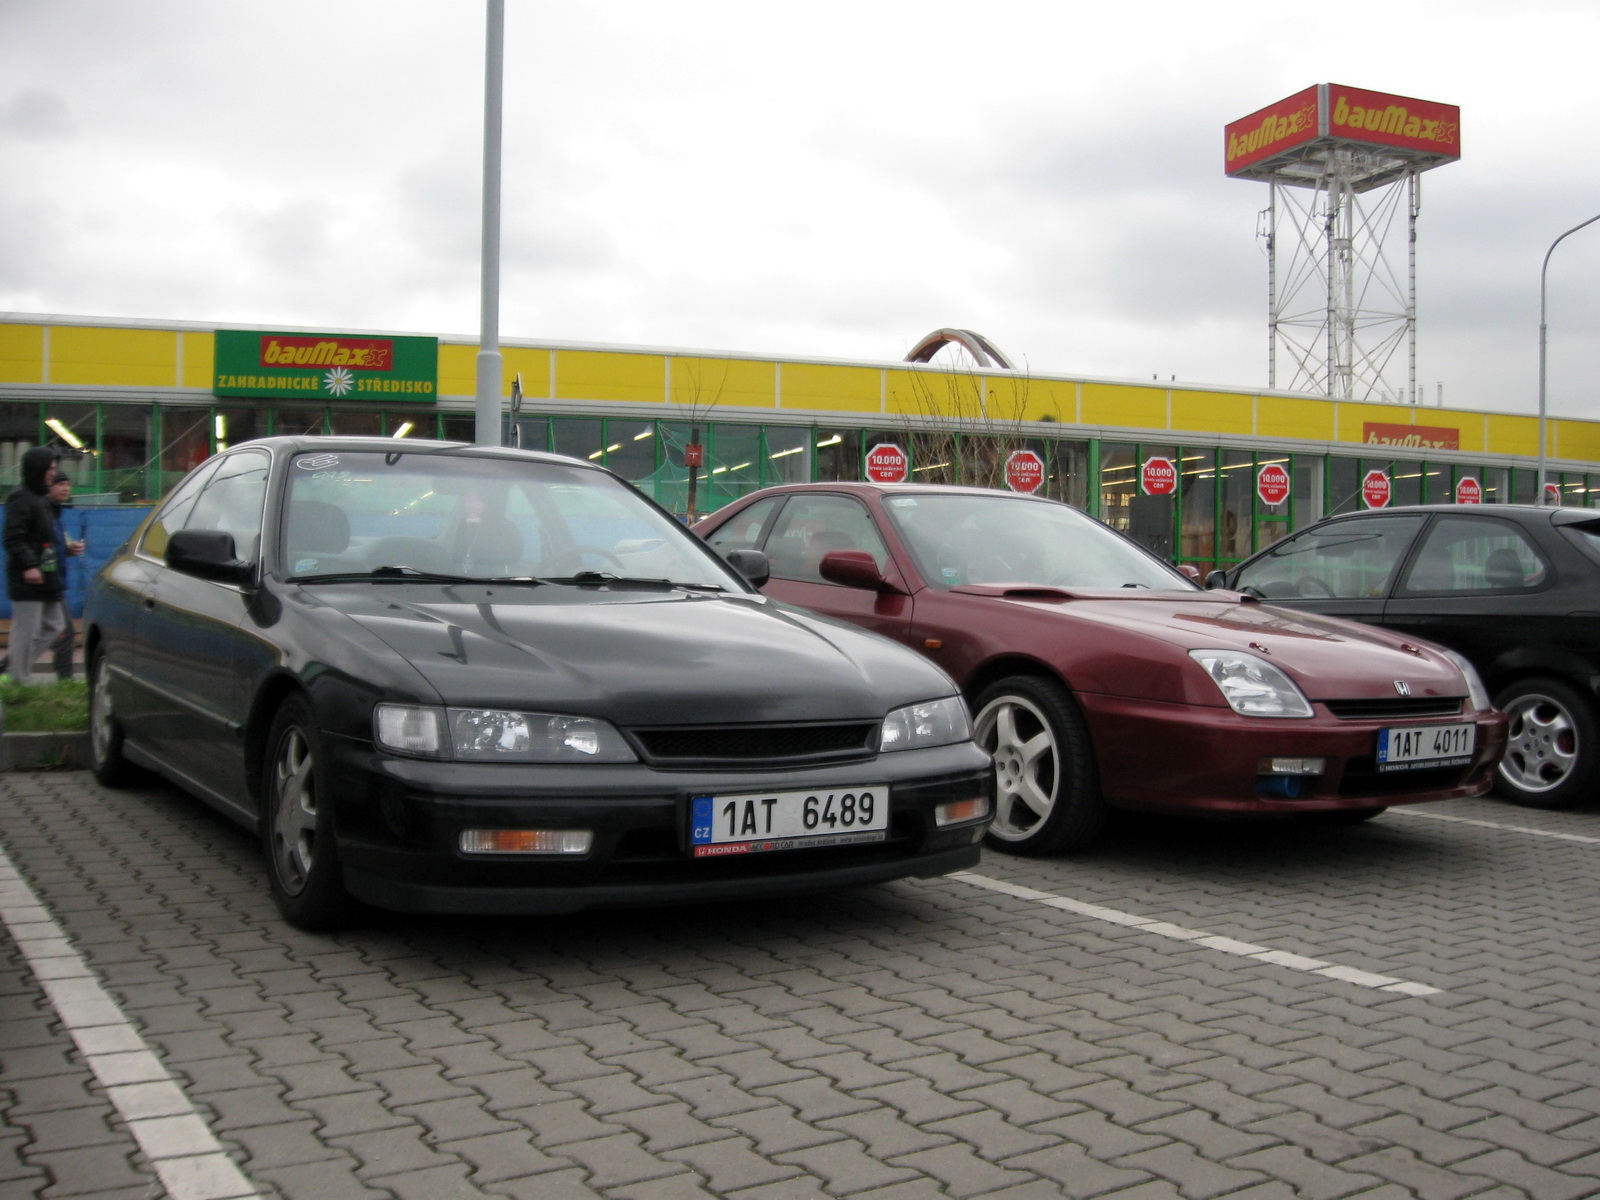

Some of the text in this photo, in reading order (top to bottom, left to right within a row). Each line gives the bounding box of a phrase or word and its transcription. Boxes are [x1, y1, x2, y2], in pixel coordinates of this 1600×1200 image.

[217, 375, 433, 394] ZAHRADNICKÉ STŘEDISKO
[871, 455, 902, 466] 10.000
[1146, 467, 1172, 477] 10.000
[1261, 473, 1285, 484] 10.000
[1393, 728, 1468, 758] 1AT 4011
[722, 792, 875, 837] 1AT 6489
[694, 827, 710, 839] CZ
[707, 845, 748, 856] HONDA
[780, 841, 794, 849] CAR
